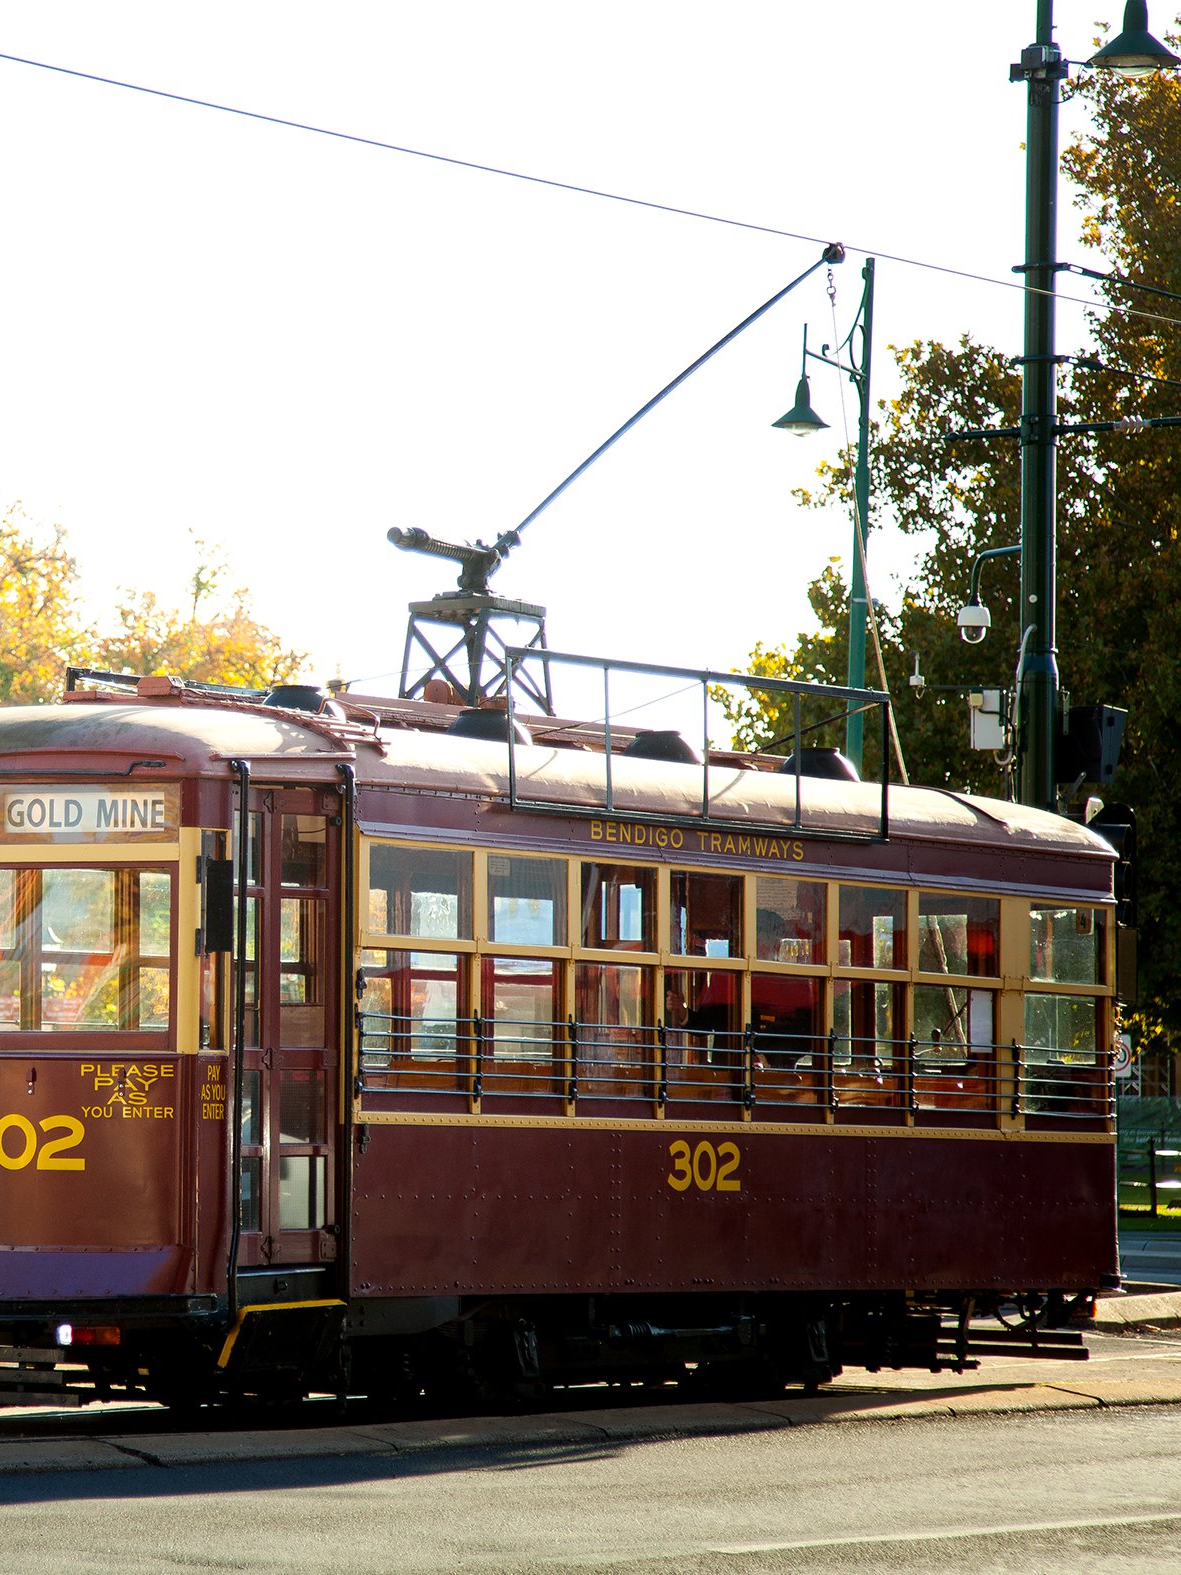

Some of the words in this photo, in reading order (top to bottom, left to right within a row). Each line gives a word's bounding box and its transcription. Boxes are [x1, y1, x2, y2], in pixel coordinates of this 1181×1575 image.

[7, 798, 83, 828] GOLD
[96, 799, 164, 829] MINE
[590, 819, 684, 849] BENDIGO
[696, 831, 804, 861] TRAMWAYS
[80, 1064, 175, 1077] PLEASE
[207, 1065, 221, 1080] PAY
[94, 1077, 159, 1092] PAY
[200, 1084, 211, 1101] AS
[211, 1085, 226, 1101] YOU
[107, 1092, 148, 1105] AS
[81, 1106, 113, 1119] YOU
[122, 1106, 174, 1119] ENTER
[202, 1103, 225, 1120] ENTER
[667, 1139, 741, 1192] 302
